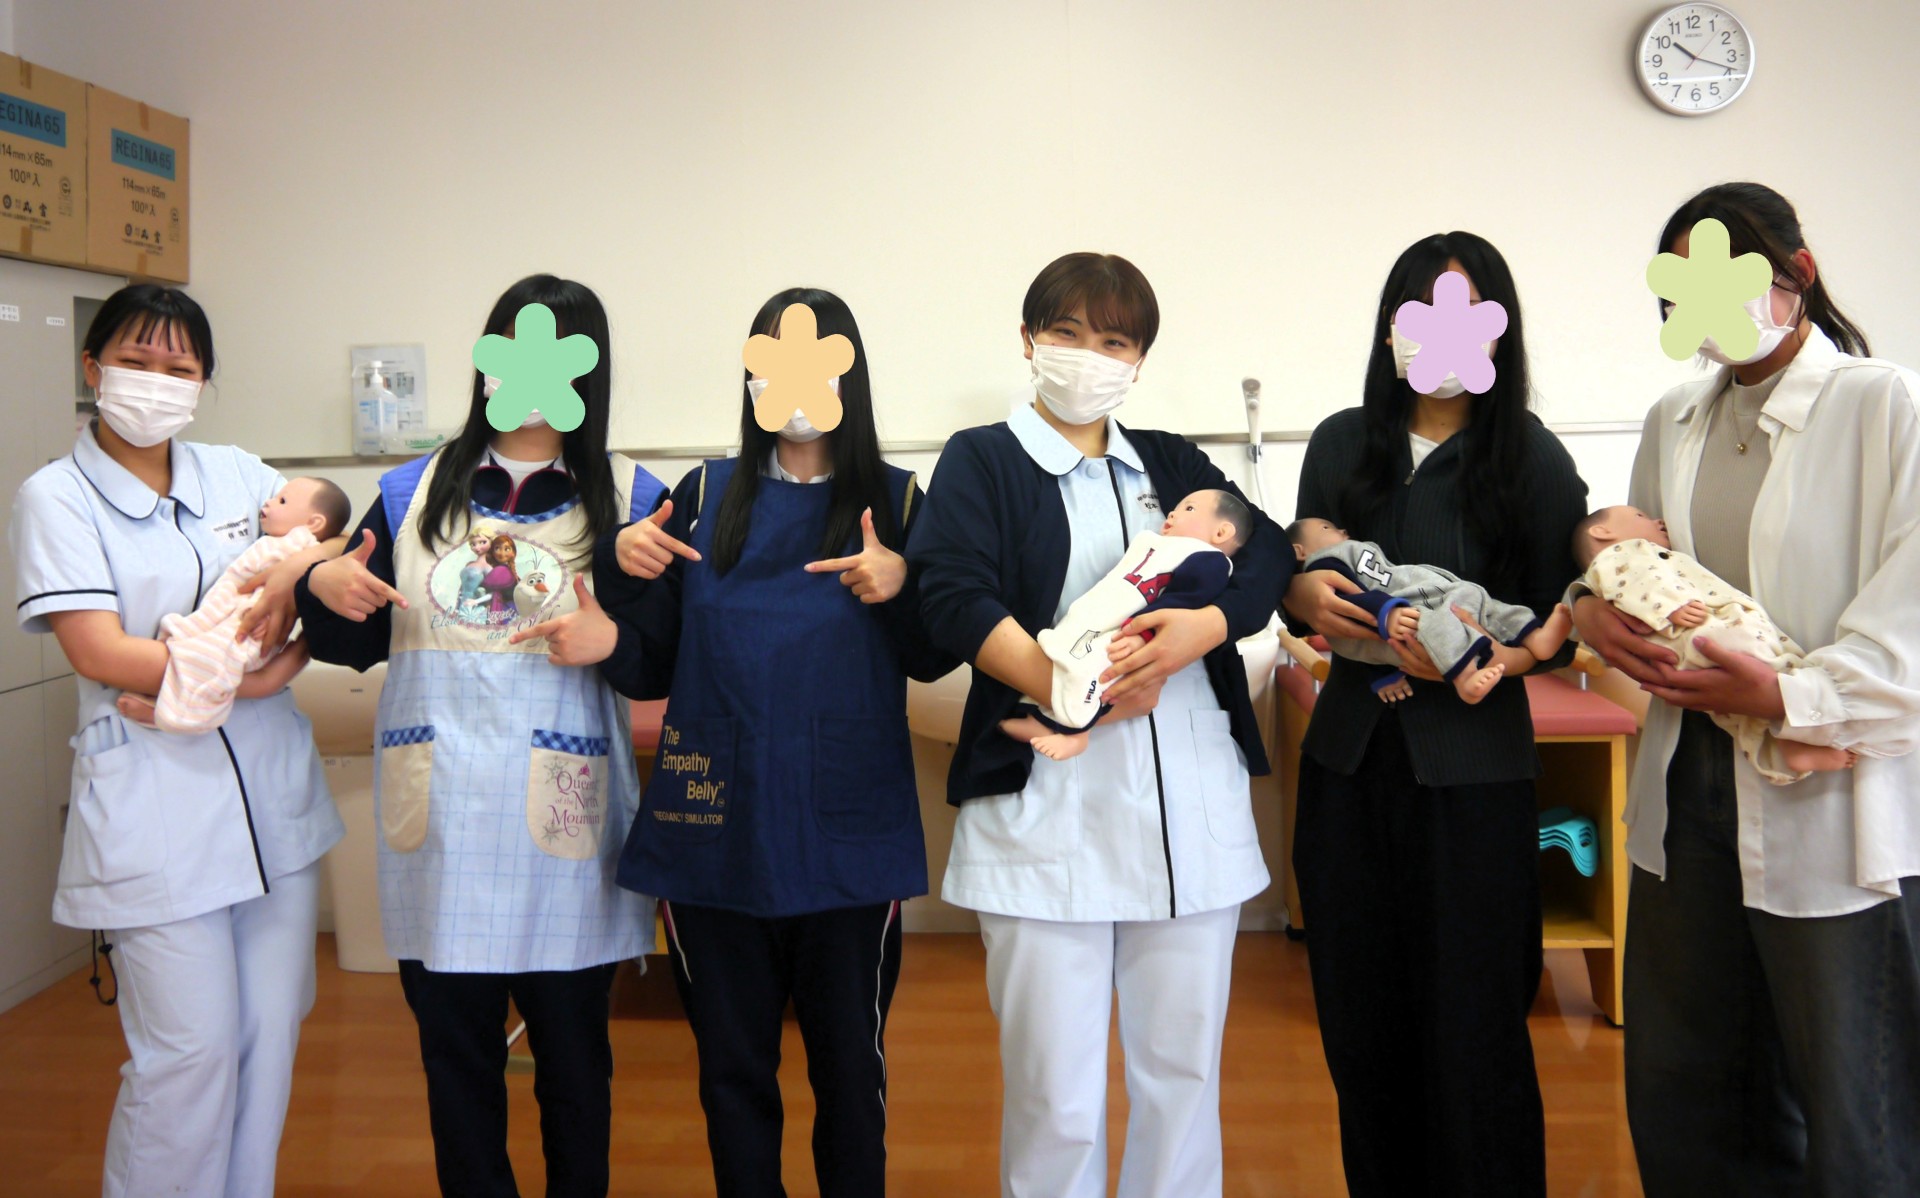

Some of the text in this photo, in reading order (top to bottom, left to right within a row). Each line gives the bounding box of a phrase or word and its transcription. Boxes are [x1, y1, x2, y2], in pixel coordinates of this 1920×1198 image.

[1669, 22, 1681, 34] 11
[1685, 15, 1701, 29] 12
[1709, 19, 1715, 32] 1
[1655, 35, 1671, 49] 10
[1721, 31, 1731, 45] 2
[1652, 54, 1663, 68] 9
[1727, 49, 1737, 63] 3
[1658, 72, 1669, 86] 8
[1672, 84, 1682, 98] 7
[1691, 88, 1701, 102] 6
[1709, 82, 1720, 96] 5
[115, 136, 172, 171] REGINA65
[1357, 550, 1392, 587] F
[664, 725, 680, 745] The
[662, 750, 710, 777] Empathy
[684, 812, 723, 825] SIMULATOR
